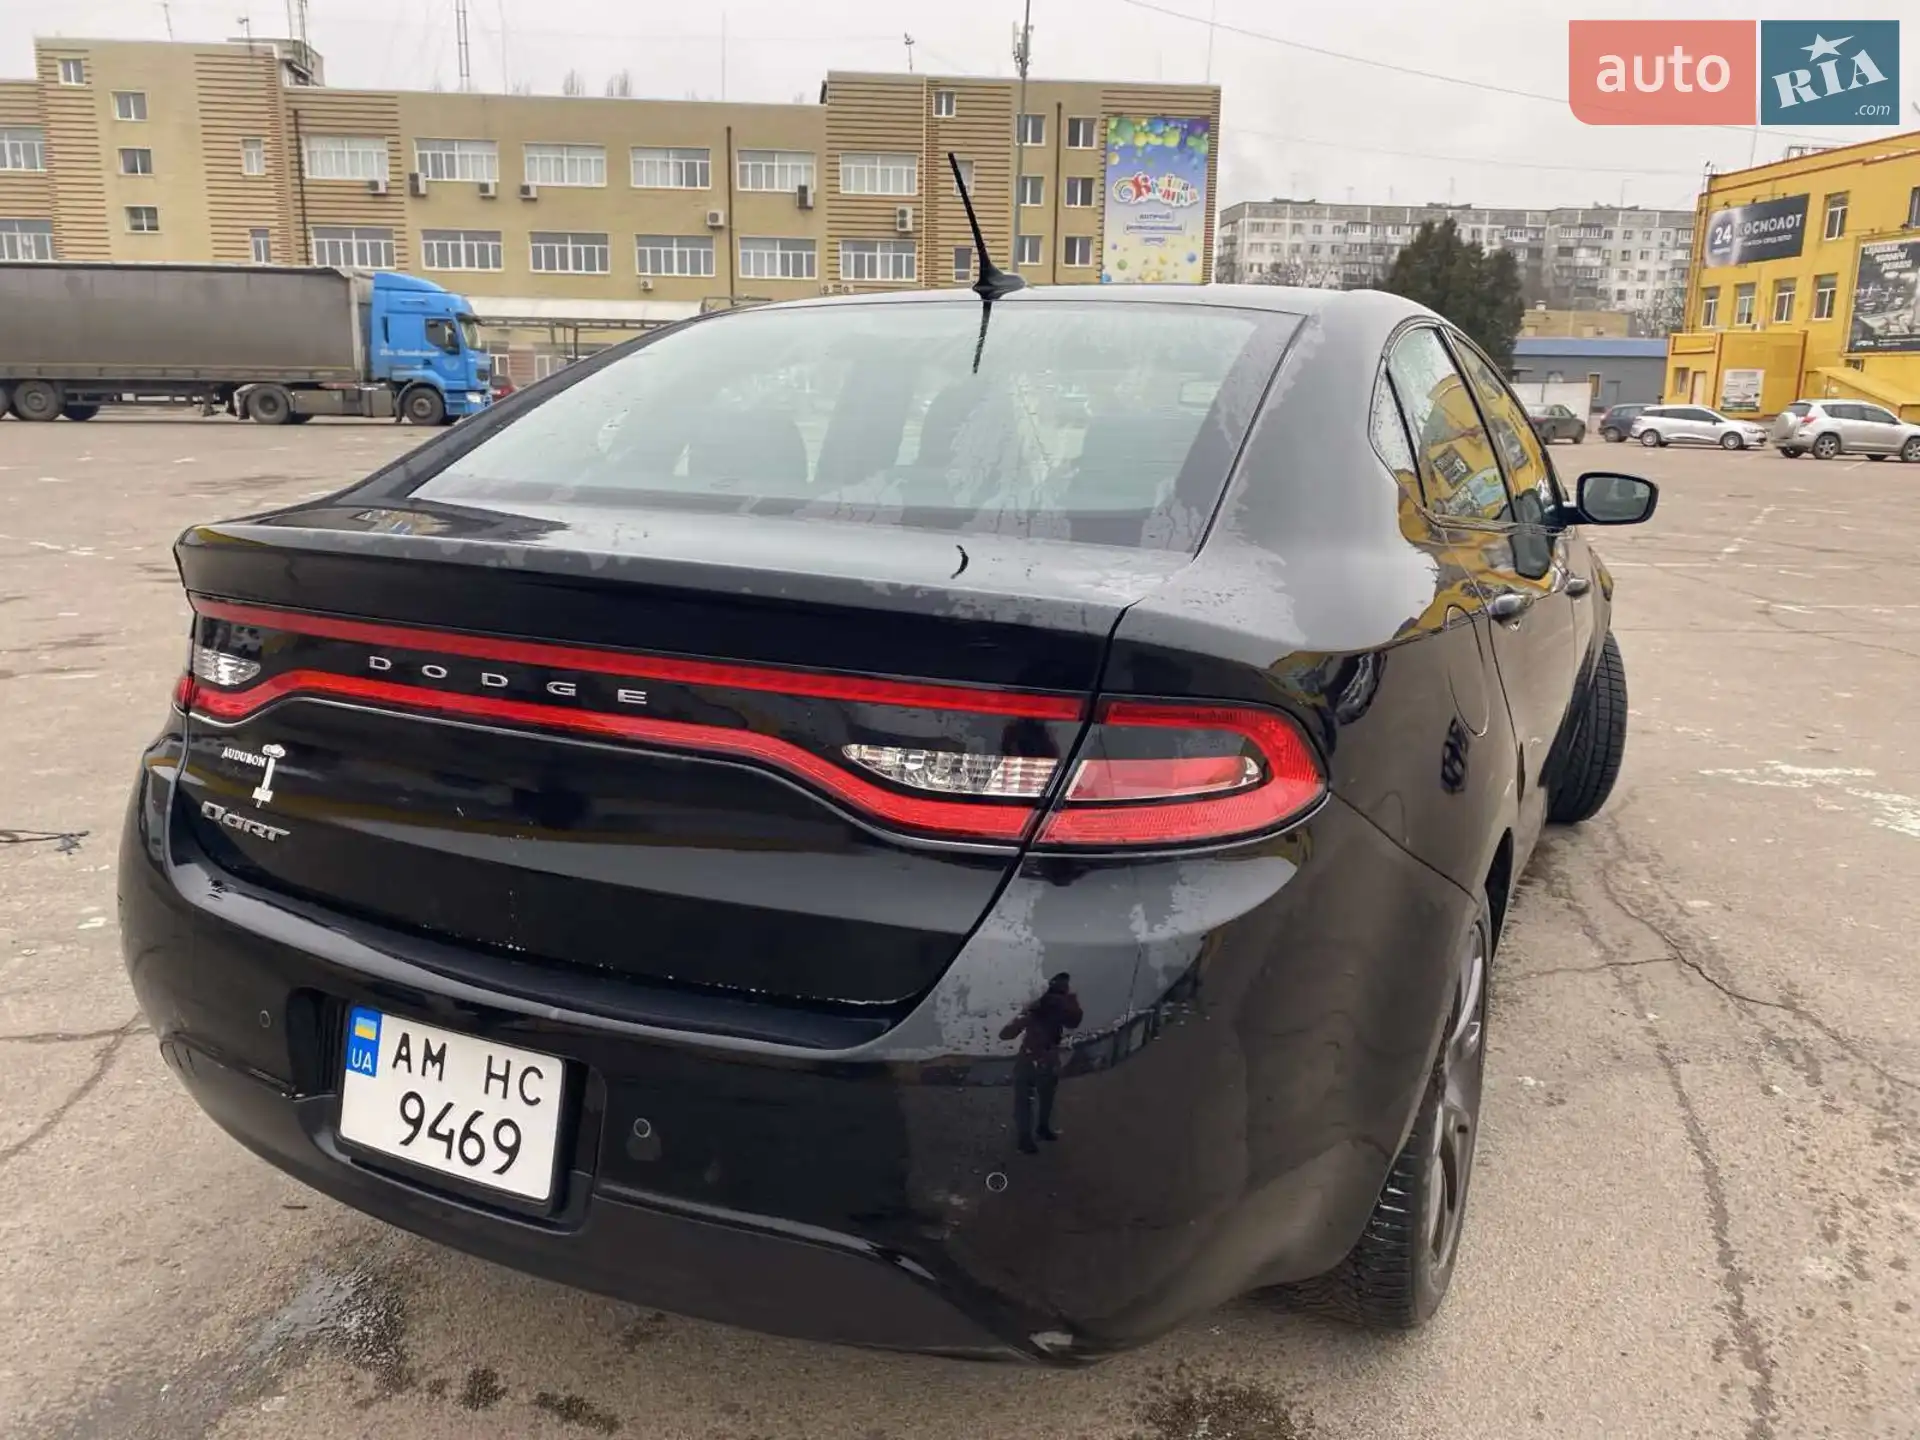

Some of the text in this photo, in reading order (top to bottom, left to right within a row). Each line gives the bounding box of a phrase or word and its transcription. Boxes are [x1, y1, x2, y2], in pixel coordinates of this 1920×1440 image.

[1713, 223, 1733, 246] 24
[368, 655, 648, 705] DODGE
[221, 746, 267, 769] AUDUBON
[351, 1047, 374, 1073] UA
[391, 1032, 545, 1107] AM HC
[398, 1090, 522, 1176] 9469
